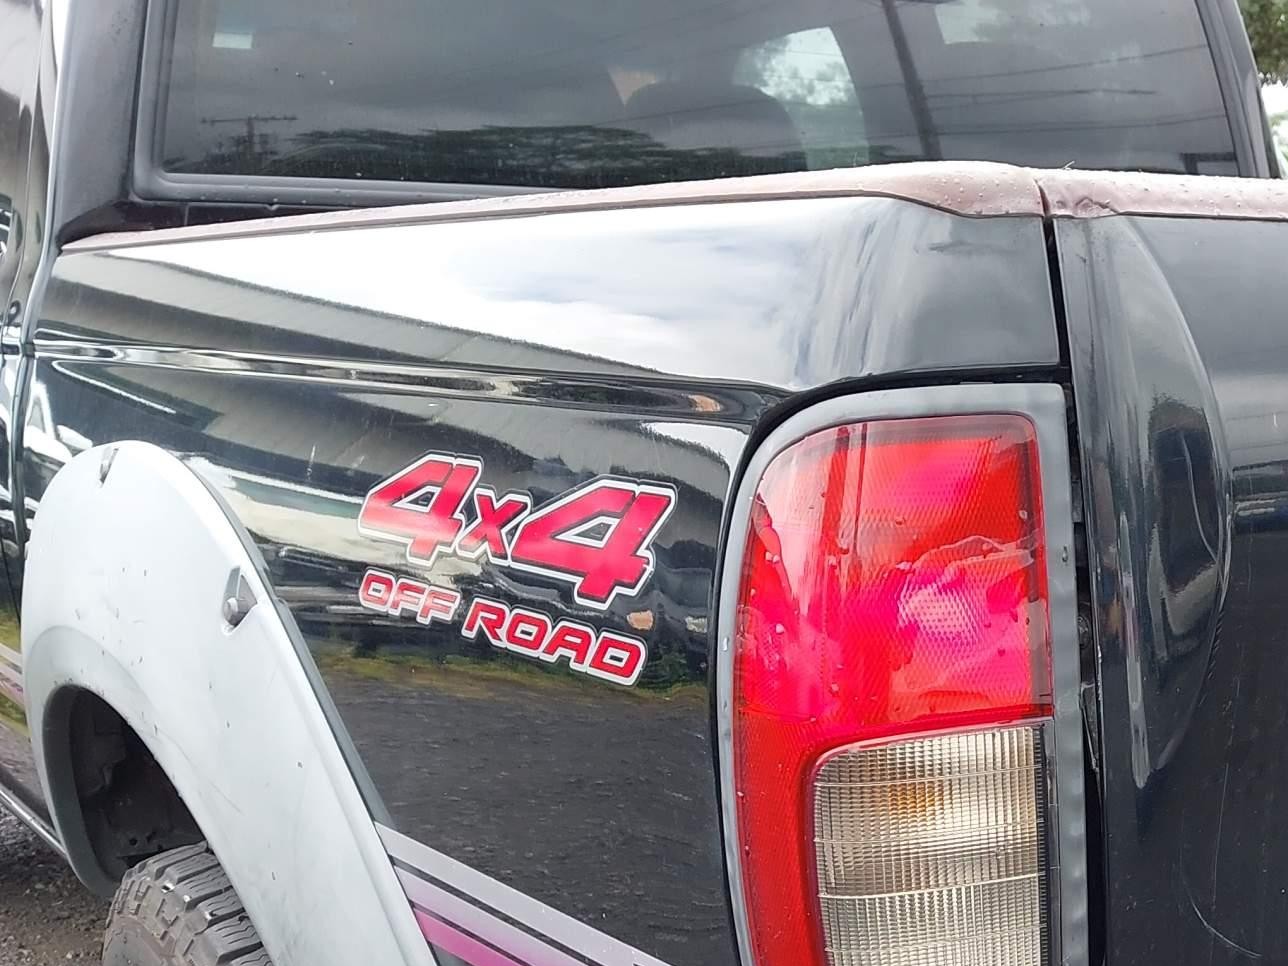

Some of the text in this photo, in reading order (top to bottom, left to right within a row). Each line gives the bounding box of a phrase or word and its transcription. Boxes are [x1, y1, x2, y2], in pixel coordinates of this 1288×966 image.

[358, 451, 677, 609] 4x4
[360, 568, 647, 686] OFF ROAD
